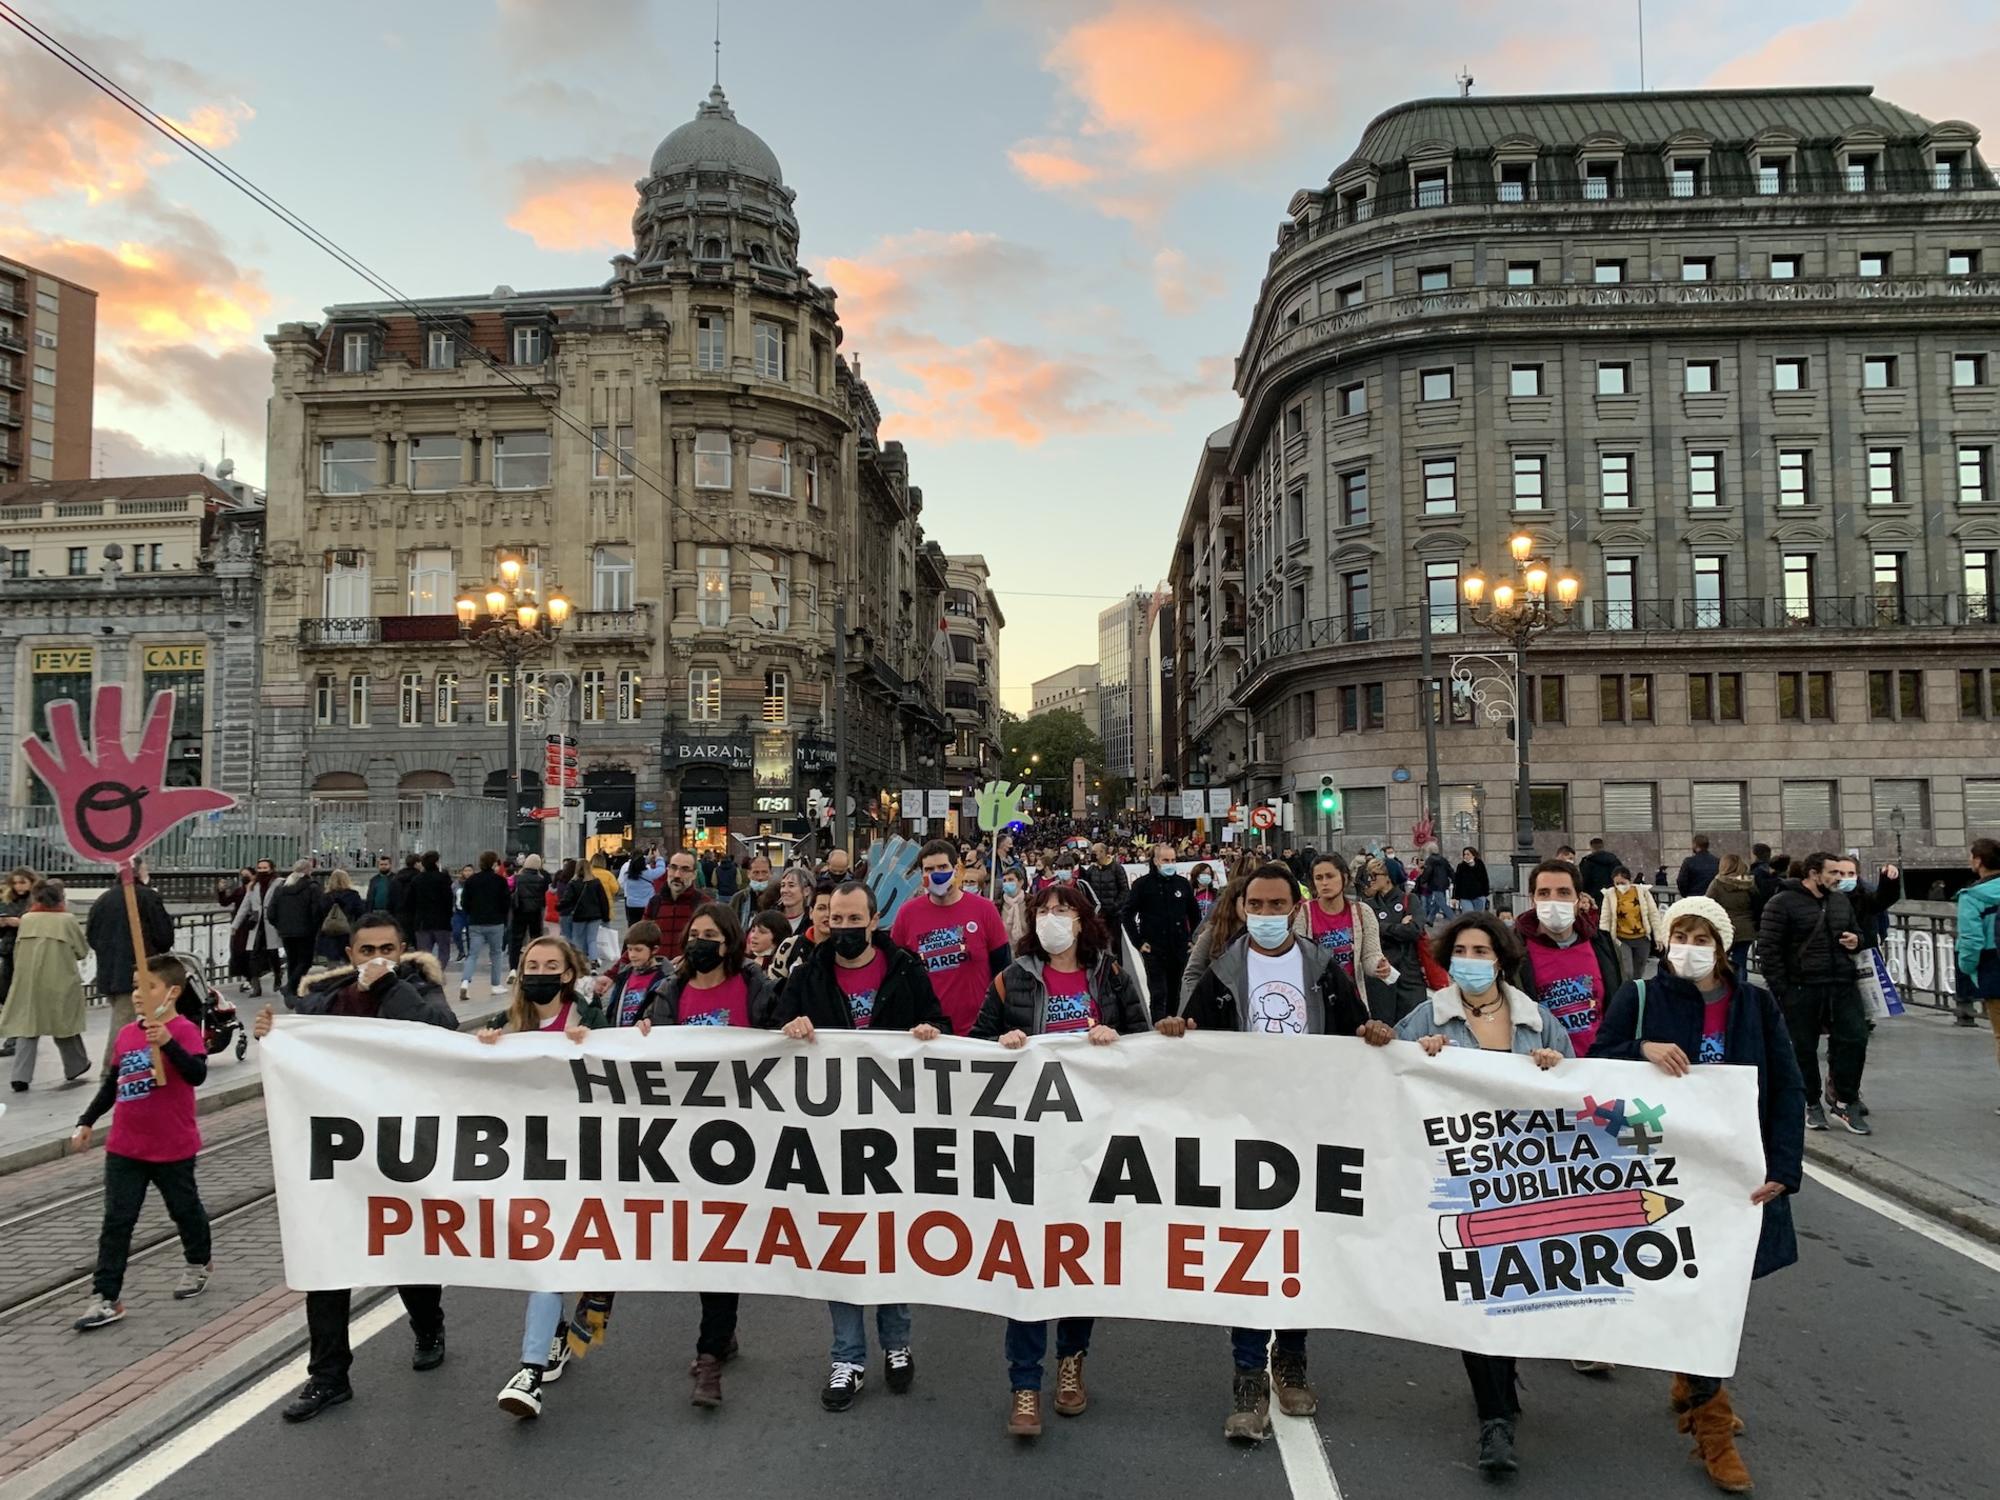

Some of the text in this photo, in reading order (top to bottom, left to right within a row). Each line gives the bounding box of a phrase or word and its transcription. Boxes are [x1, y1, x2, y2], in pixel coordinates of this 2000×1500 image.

[35, 652, 92, 670] FEVE
[147, 650, 204, 667] CAFE
[757, 797, 790, 811] 17:51
[569, 1056, 1083, 1122] HEZKUNTZA
[1423, 1107, 1576, 1147] EUSKAL
[310, 1115, 1364, 1217] PUBLIKOAREN ALDE
[1445, 1134, 1600, 1177] ESKOLA
[1468, 1156, 1679, 1209] PUBLIKOAZ
[367, 1195, 1302, 1299] PRIBATIZAZIOARI EZ!
[1438, 1226, 1699, 1302] HARRO!
